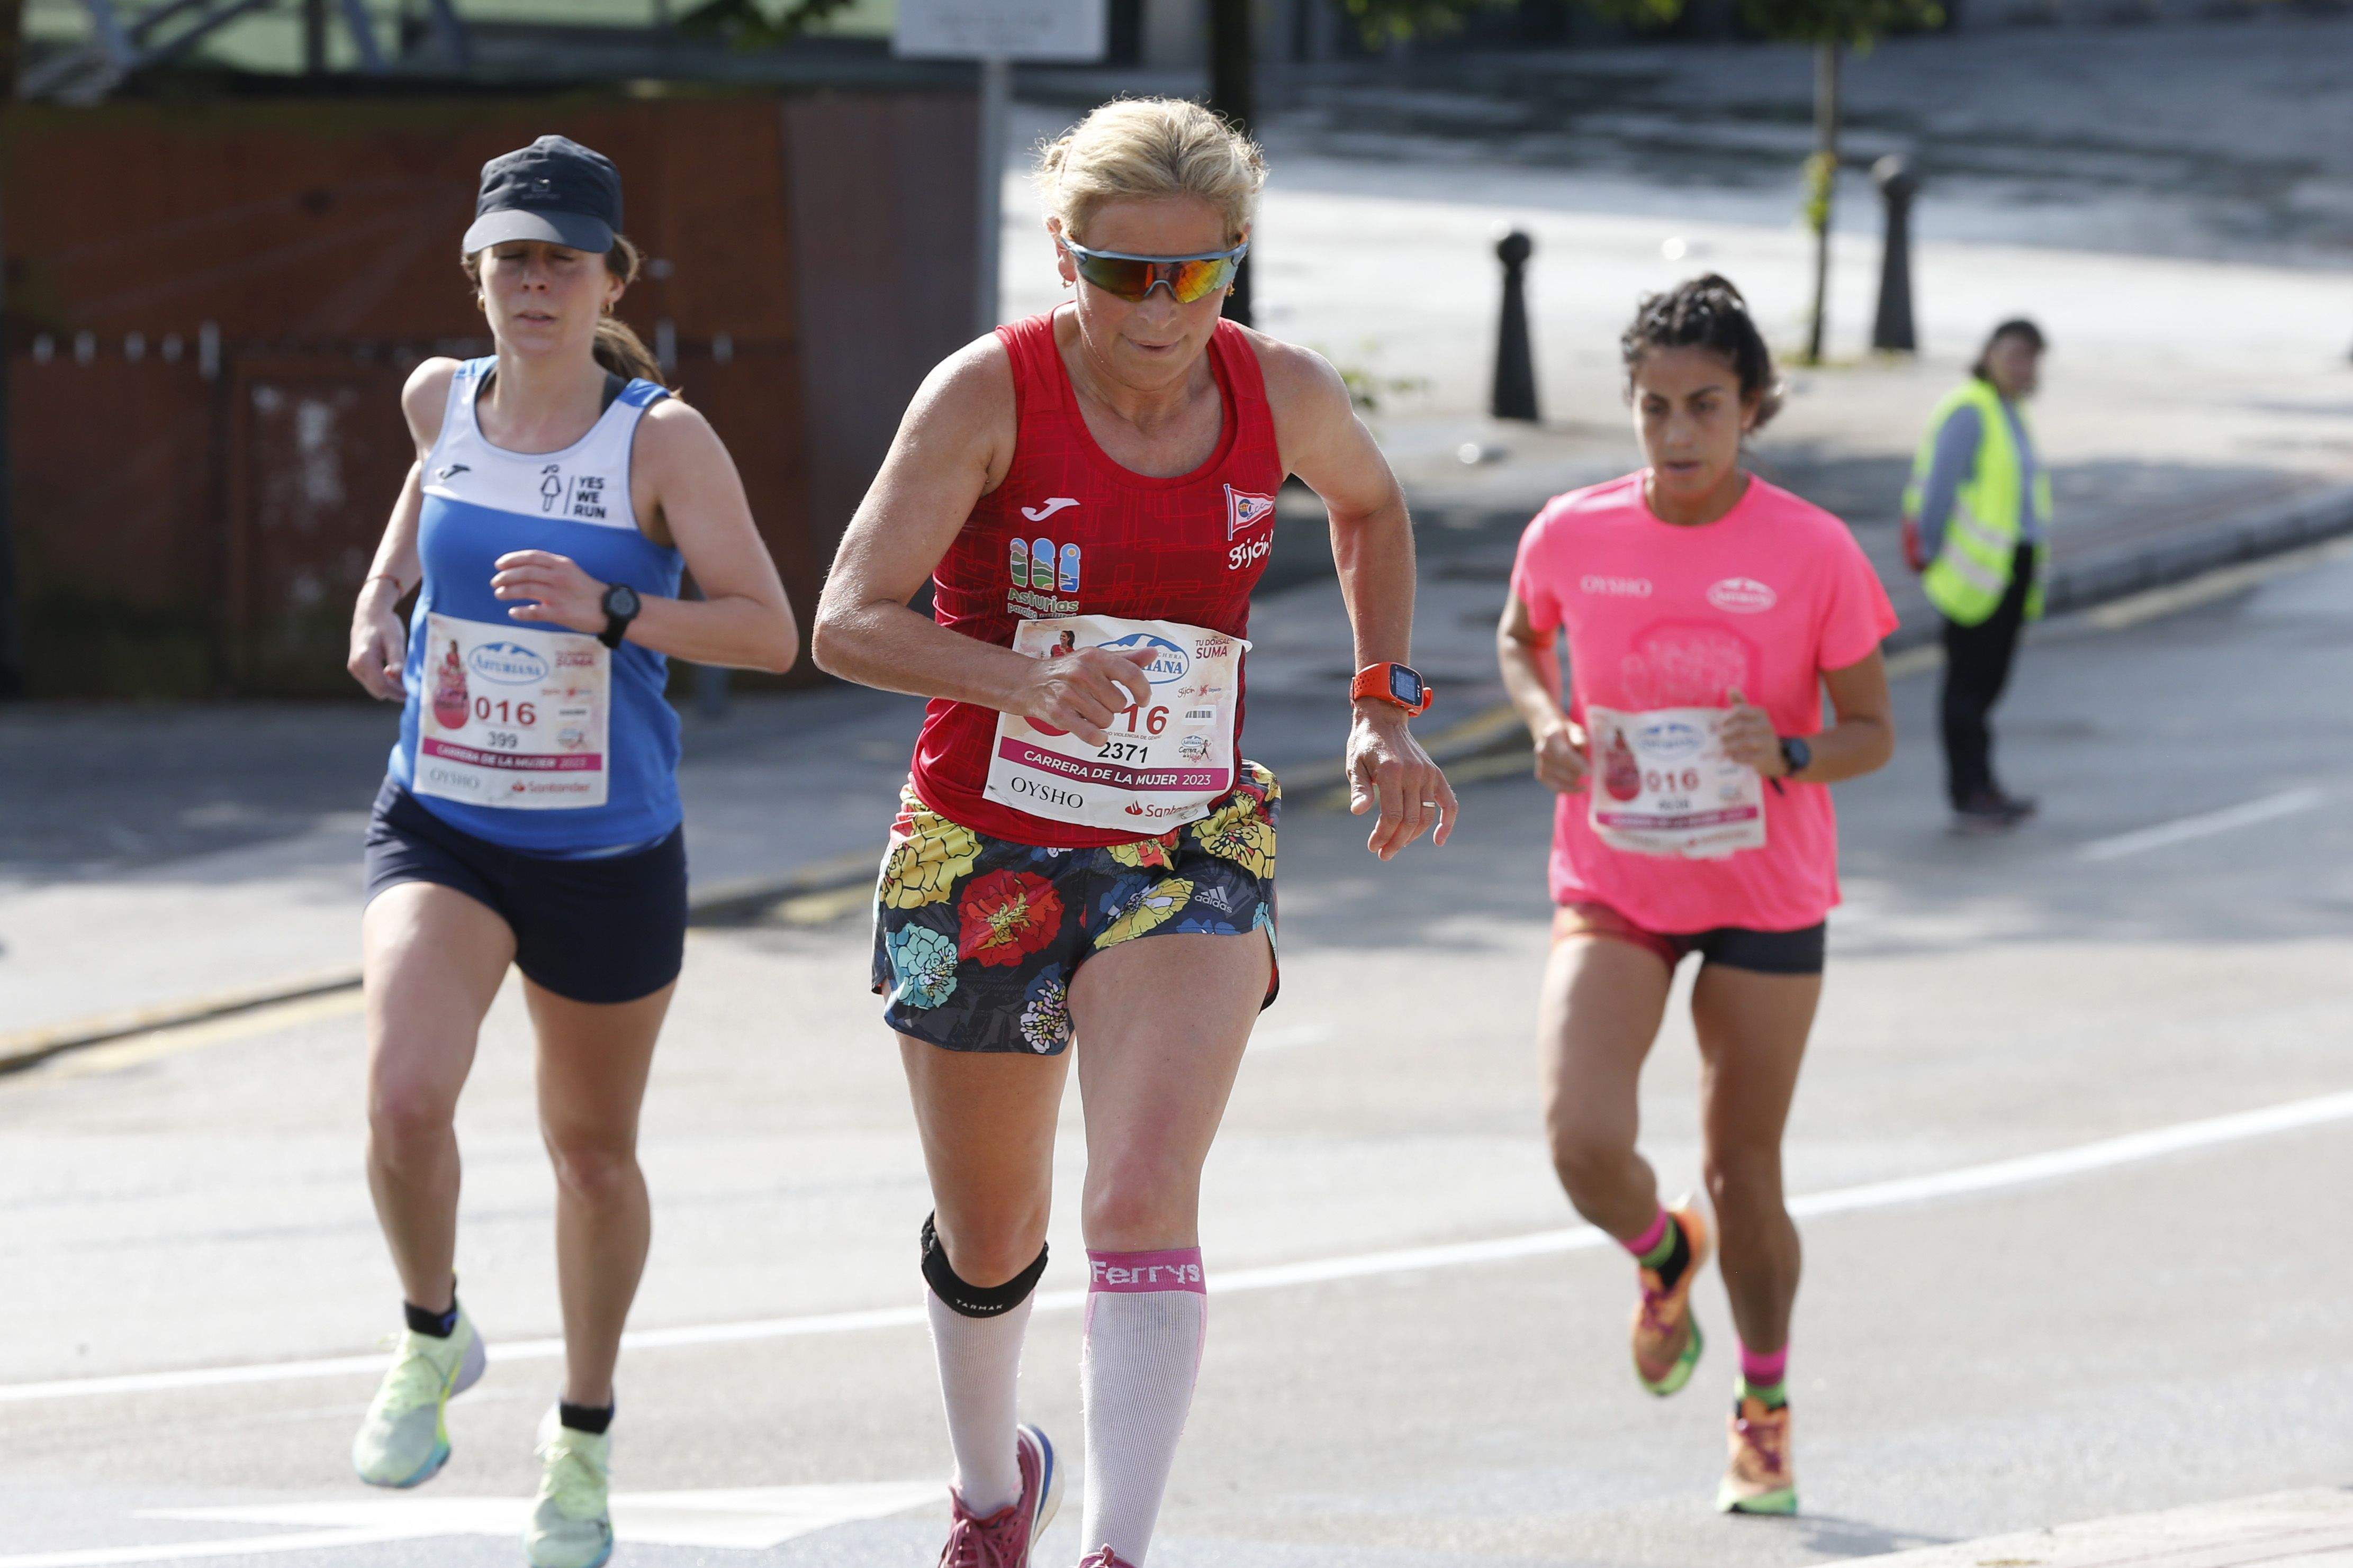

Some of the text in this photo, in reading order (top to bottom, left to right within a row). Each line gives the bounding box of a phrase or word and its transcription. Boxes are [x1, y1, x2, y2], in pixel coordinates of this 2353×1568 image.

[580, 476, 604, 490] YES
[577, 491, 598, 503] WE
[574, 504, 606, 518] RUN
[1007, 587, 1079, 612] Asturias
[1196, 646, 1228, 659] SUMA
[475, 697, 536, 726] 016
[1121, 703, 1169, 735] 16
[488, 731, 518, 748] 399
[1097, 741, 1148, 763] 2371
[1024, 750, 1211, 785] CARRERA DE LA MUJER 2023
[529, 781, 590, 793] Santander
[1011, 777, 1084, 808] OYSHO
[1194, 895, 1232, 913] adidas
[1089, 1260, 1201, 1285] Ferrys
[955, 1298, 1004, 1310] TARMAK
